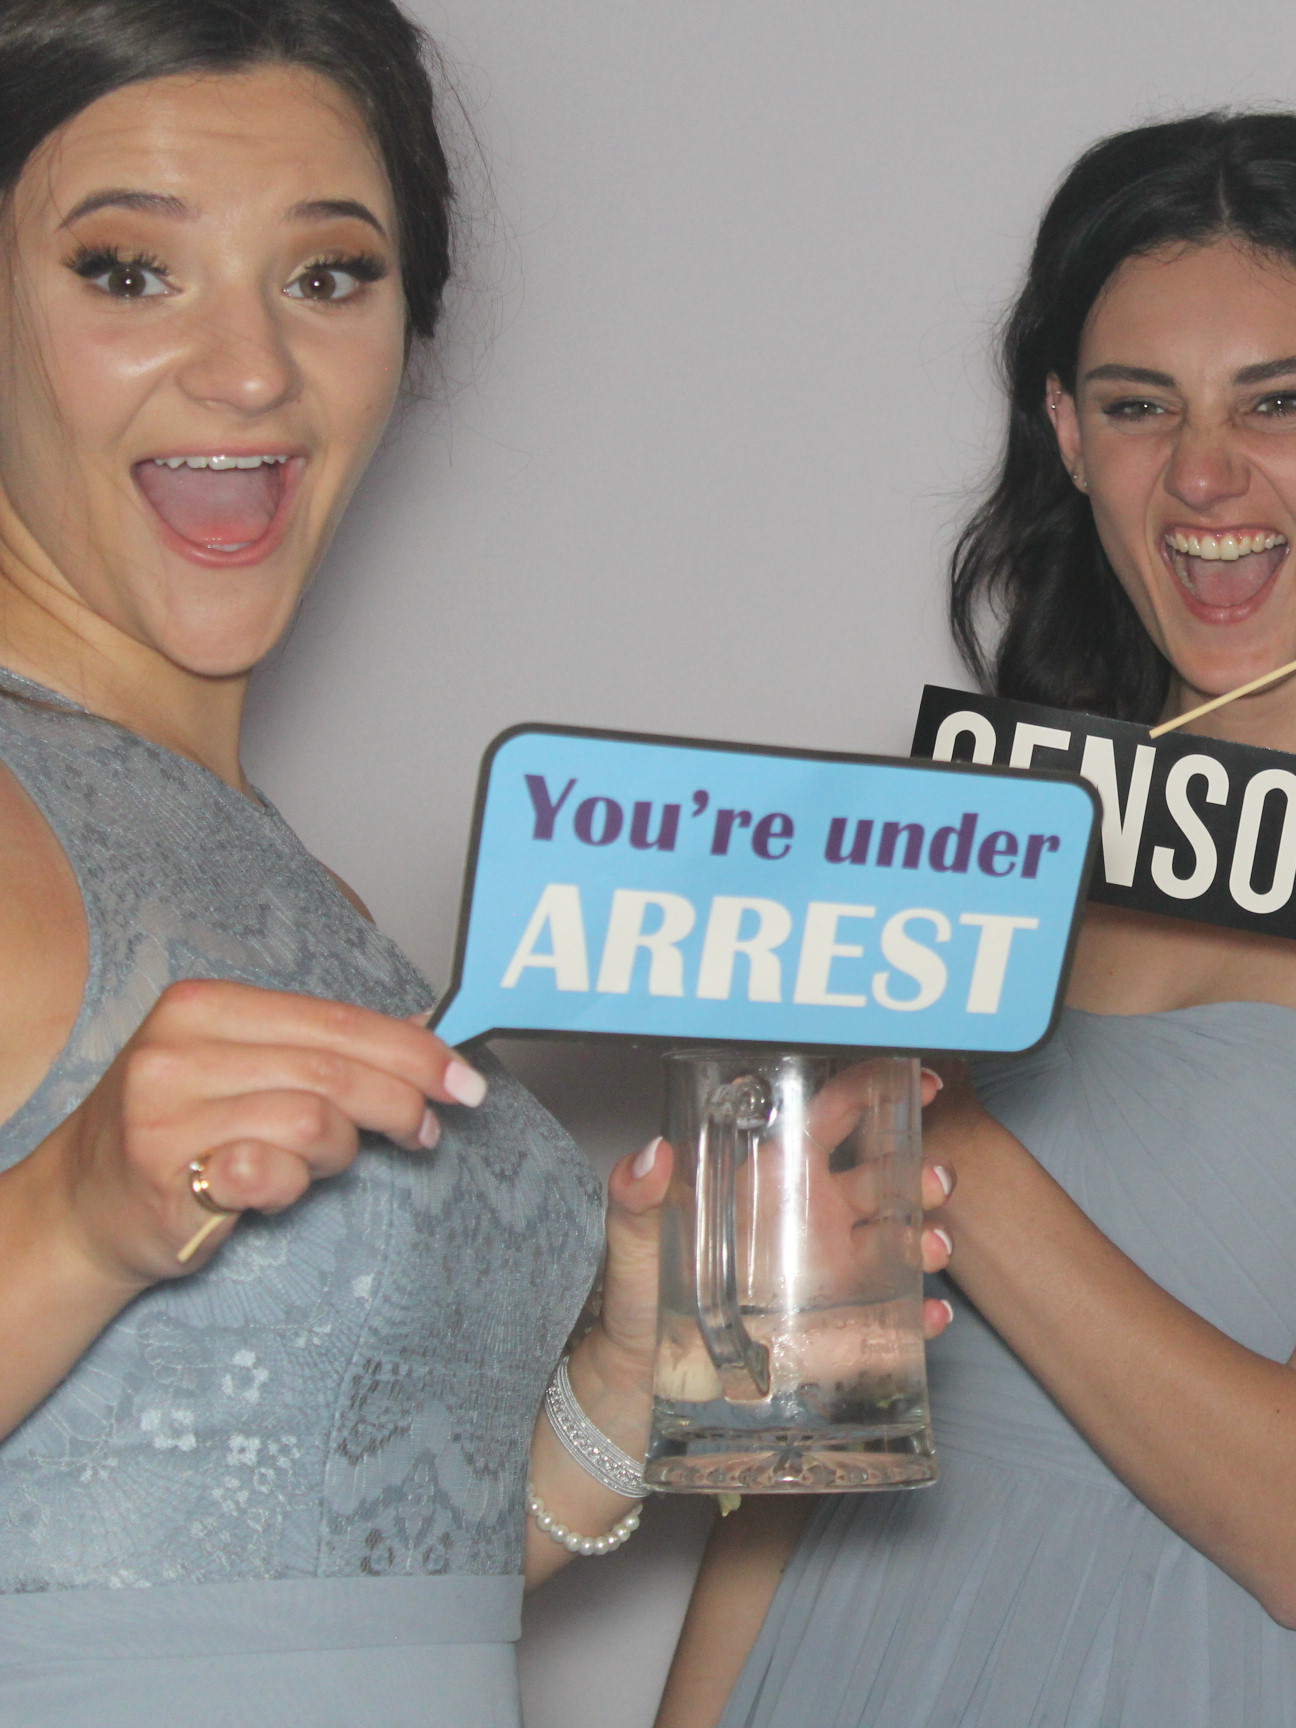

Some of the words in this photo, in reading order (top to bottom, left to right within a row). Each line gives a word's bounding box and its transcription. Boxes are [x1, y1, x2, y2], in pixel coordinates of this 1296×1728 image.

[523, 773, 795, 861] You’re
[823, 812, 1061, 880] under
[500, 883, 1040, 1015] ARREST
